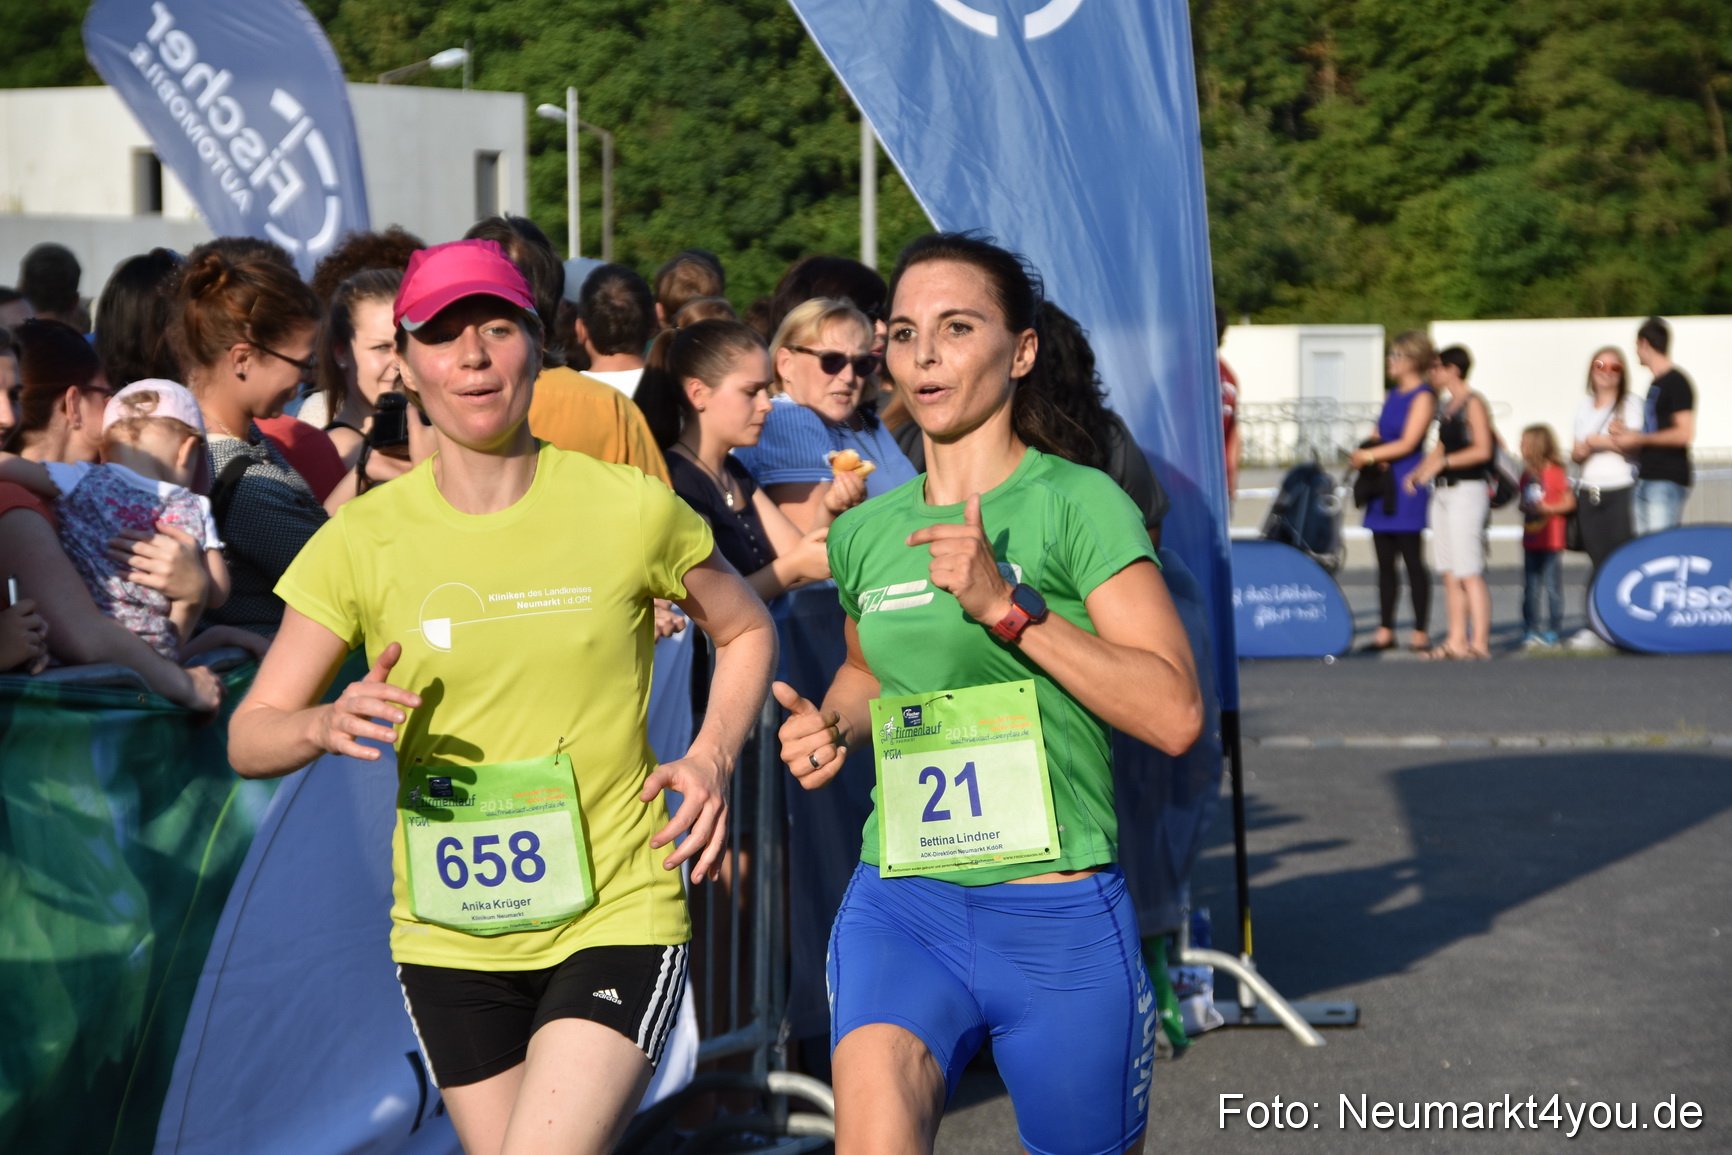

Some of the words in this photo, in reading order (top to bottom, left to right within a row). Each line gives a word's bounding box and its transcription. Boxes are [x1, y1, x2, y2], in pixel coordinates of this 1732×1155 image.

[488, 590, 525, 602] Kliniken
[527, 589, 543, 598] des
[544, 586, 592, 596] Landkreises
[1649, 567, 1732, 613] Fisc
[516, 598, 561, 610] Neumarkt
[896, 721, 942, 739] firmenlauf
[945, 725, 978, 740] 2015
[918, 761, 983, 823] 21
[479, 798, 514, 813] 2015
[920, 835, 955, 847] Bettina
[956, 830, 1001, 844] Lindner
[958, 846, 986, 856] Neumarkt
[436, 830, 546, 890] 658
[461, 901, 492, 912] Anika
[493, 897, 532, 910] Krüger
[496, 911, 524, 919] Neumarkt
[592, 991, 623, 1005] adidas
